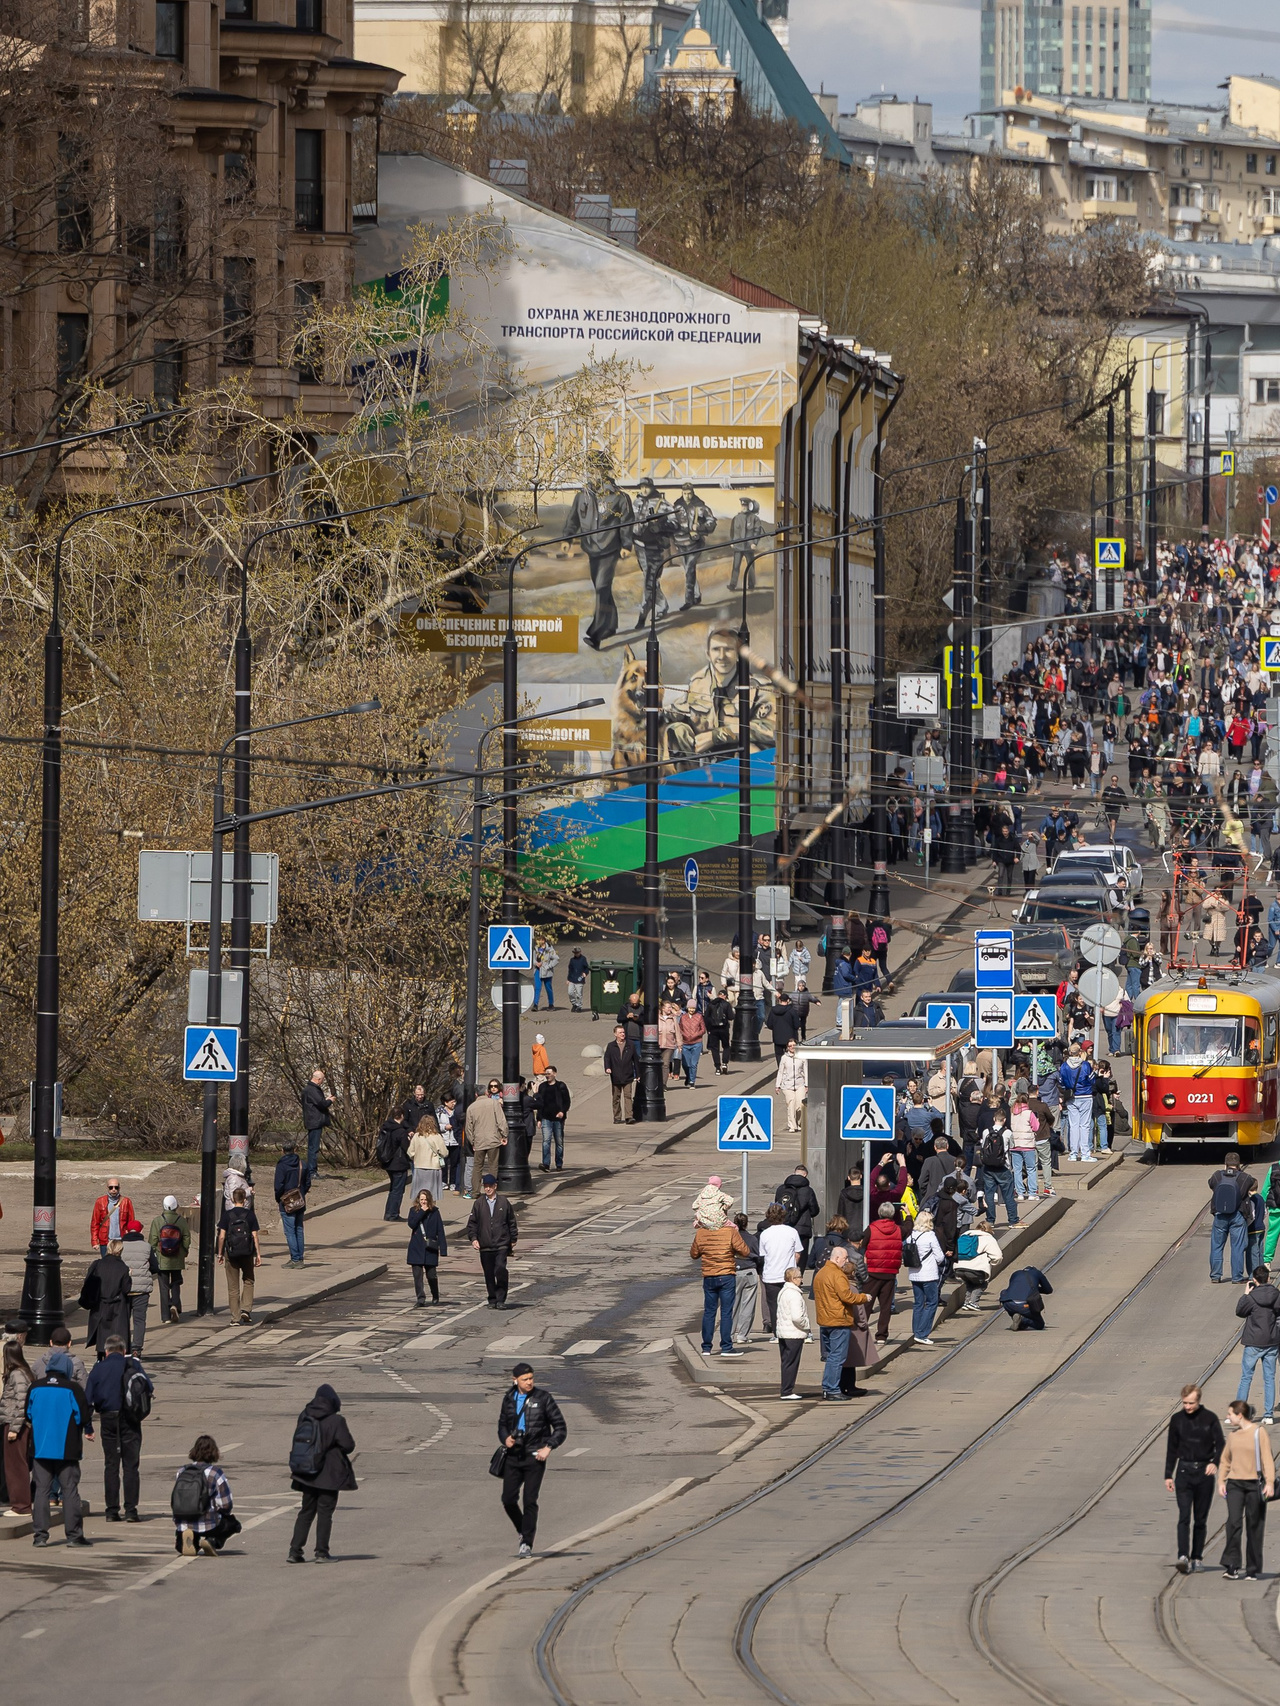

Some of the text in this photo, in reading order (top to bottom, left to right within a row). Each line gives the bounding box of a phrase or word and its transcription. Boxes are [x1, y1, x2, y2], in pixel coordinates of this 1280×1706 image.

[527, 308, 730, 324] ОХРАНА ЖЕЛЕЗНОДОРОЖНОГО
[501, 325, 762, 344] ТРАНСПОРТА РОССИЙСКОЙ ФЕДЕРАЦИИ
[656, 436, 764, 450] ОХРАНА ОБЪЕКТОВ
[416, 618, 496, 631] ОБЕСПЕЧЕНИЕ
[446, 634, 537, 648] БЕЗОПАСНСТИ
[1188, 1094, 1214, 1103] 0221
